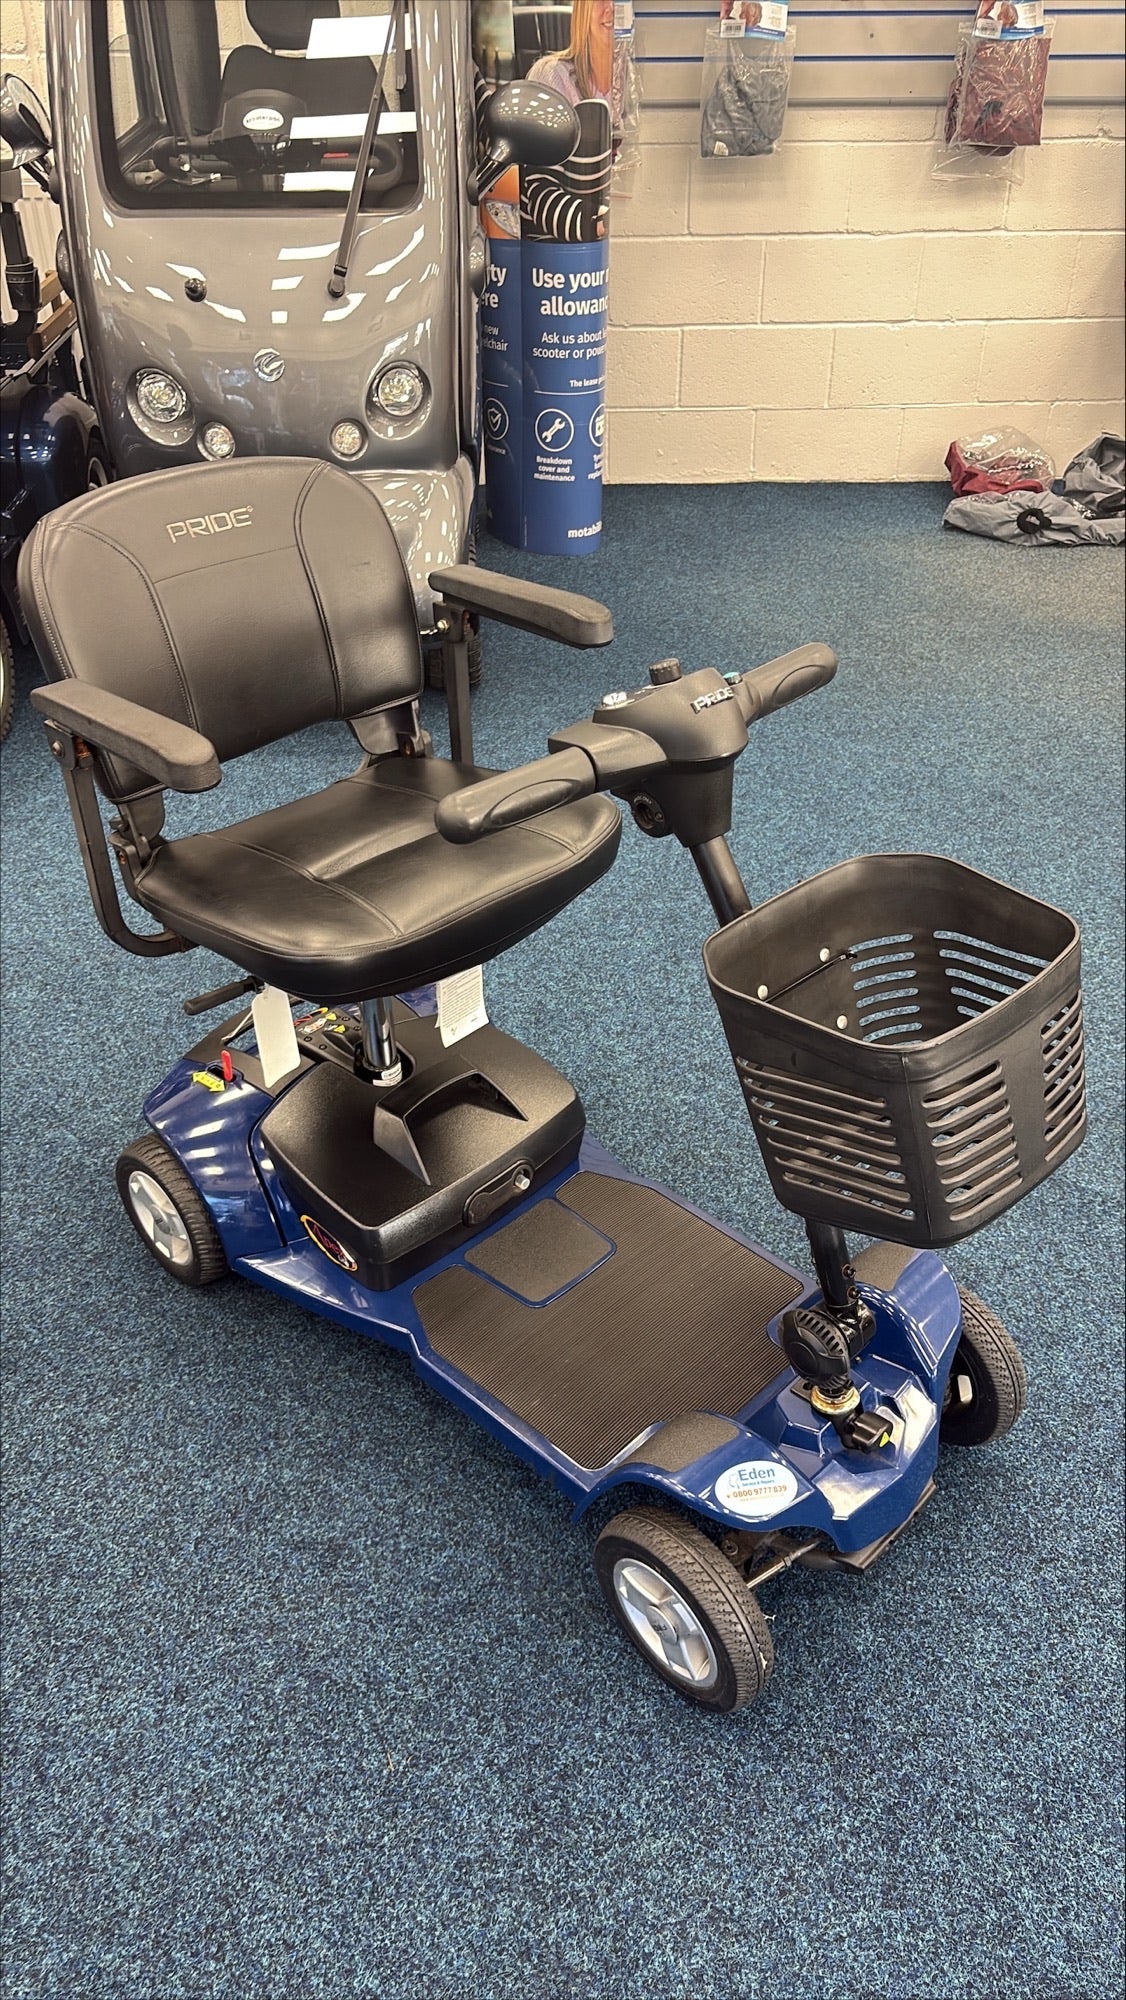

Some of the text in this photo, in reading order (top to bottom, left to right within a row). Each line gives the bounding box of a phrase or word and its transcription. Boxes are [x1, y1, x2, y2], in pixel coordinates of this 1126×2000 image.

[532, 267, 565, 288] Use
[569, 270, 605, 294] your
[541, 332, 560, 344] Ask
[562, 335, 575, 344] us
[577, 330, 602, 344] about
[532, 347, 570, 359] scooter
[572, 349, 584, 359] or
[569, 379, 582, 388] The
[536, 455, 573, 465] Breakdown
[538, 465, 556, 473] cover
[533, 472, 576, 482] maintenance
[166, 507, 253, 544] PRIDE
[690, 686, 735, 714] PRIDE
[738, 1467, 776, 1482] Eden
[732, 1489, 753, 1498] 0800
